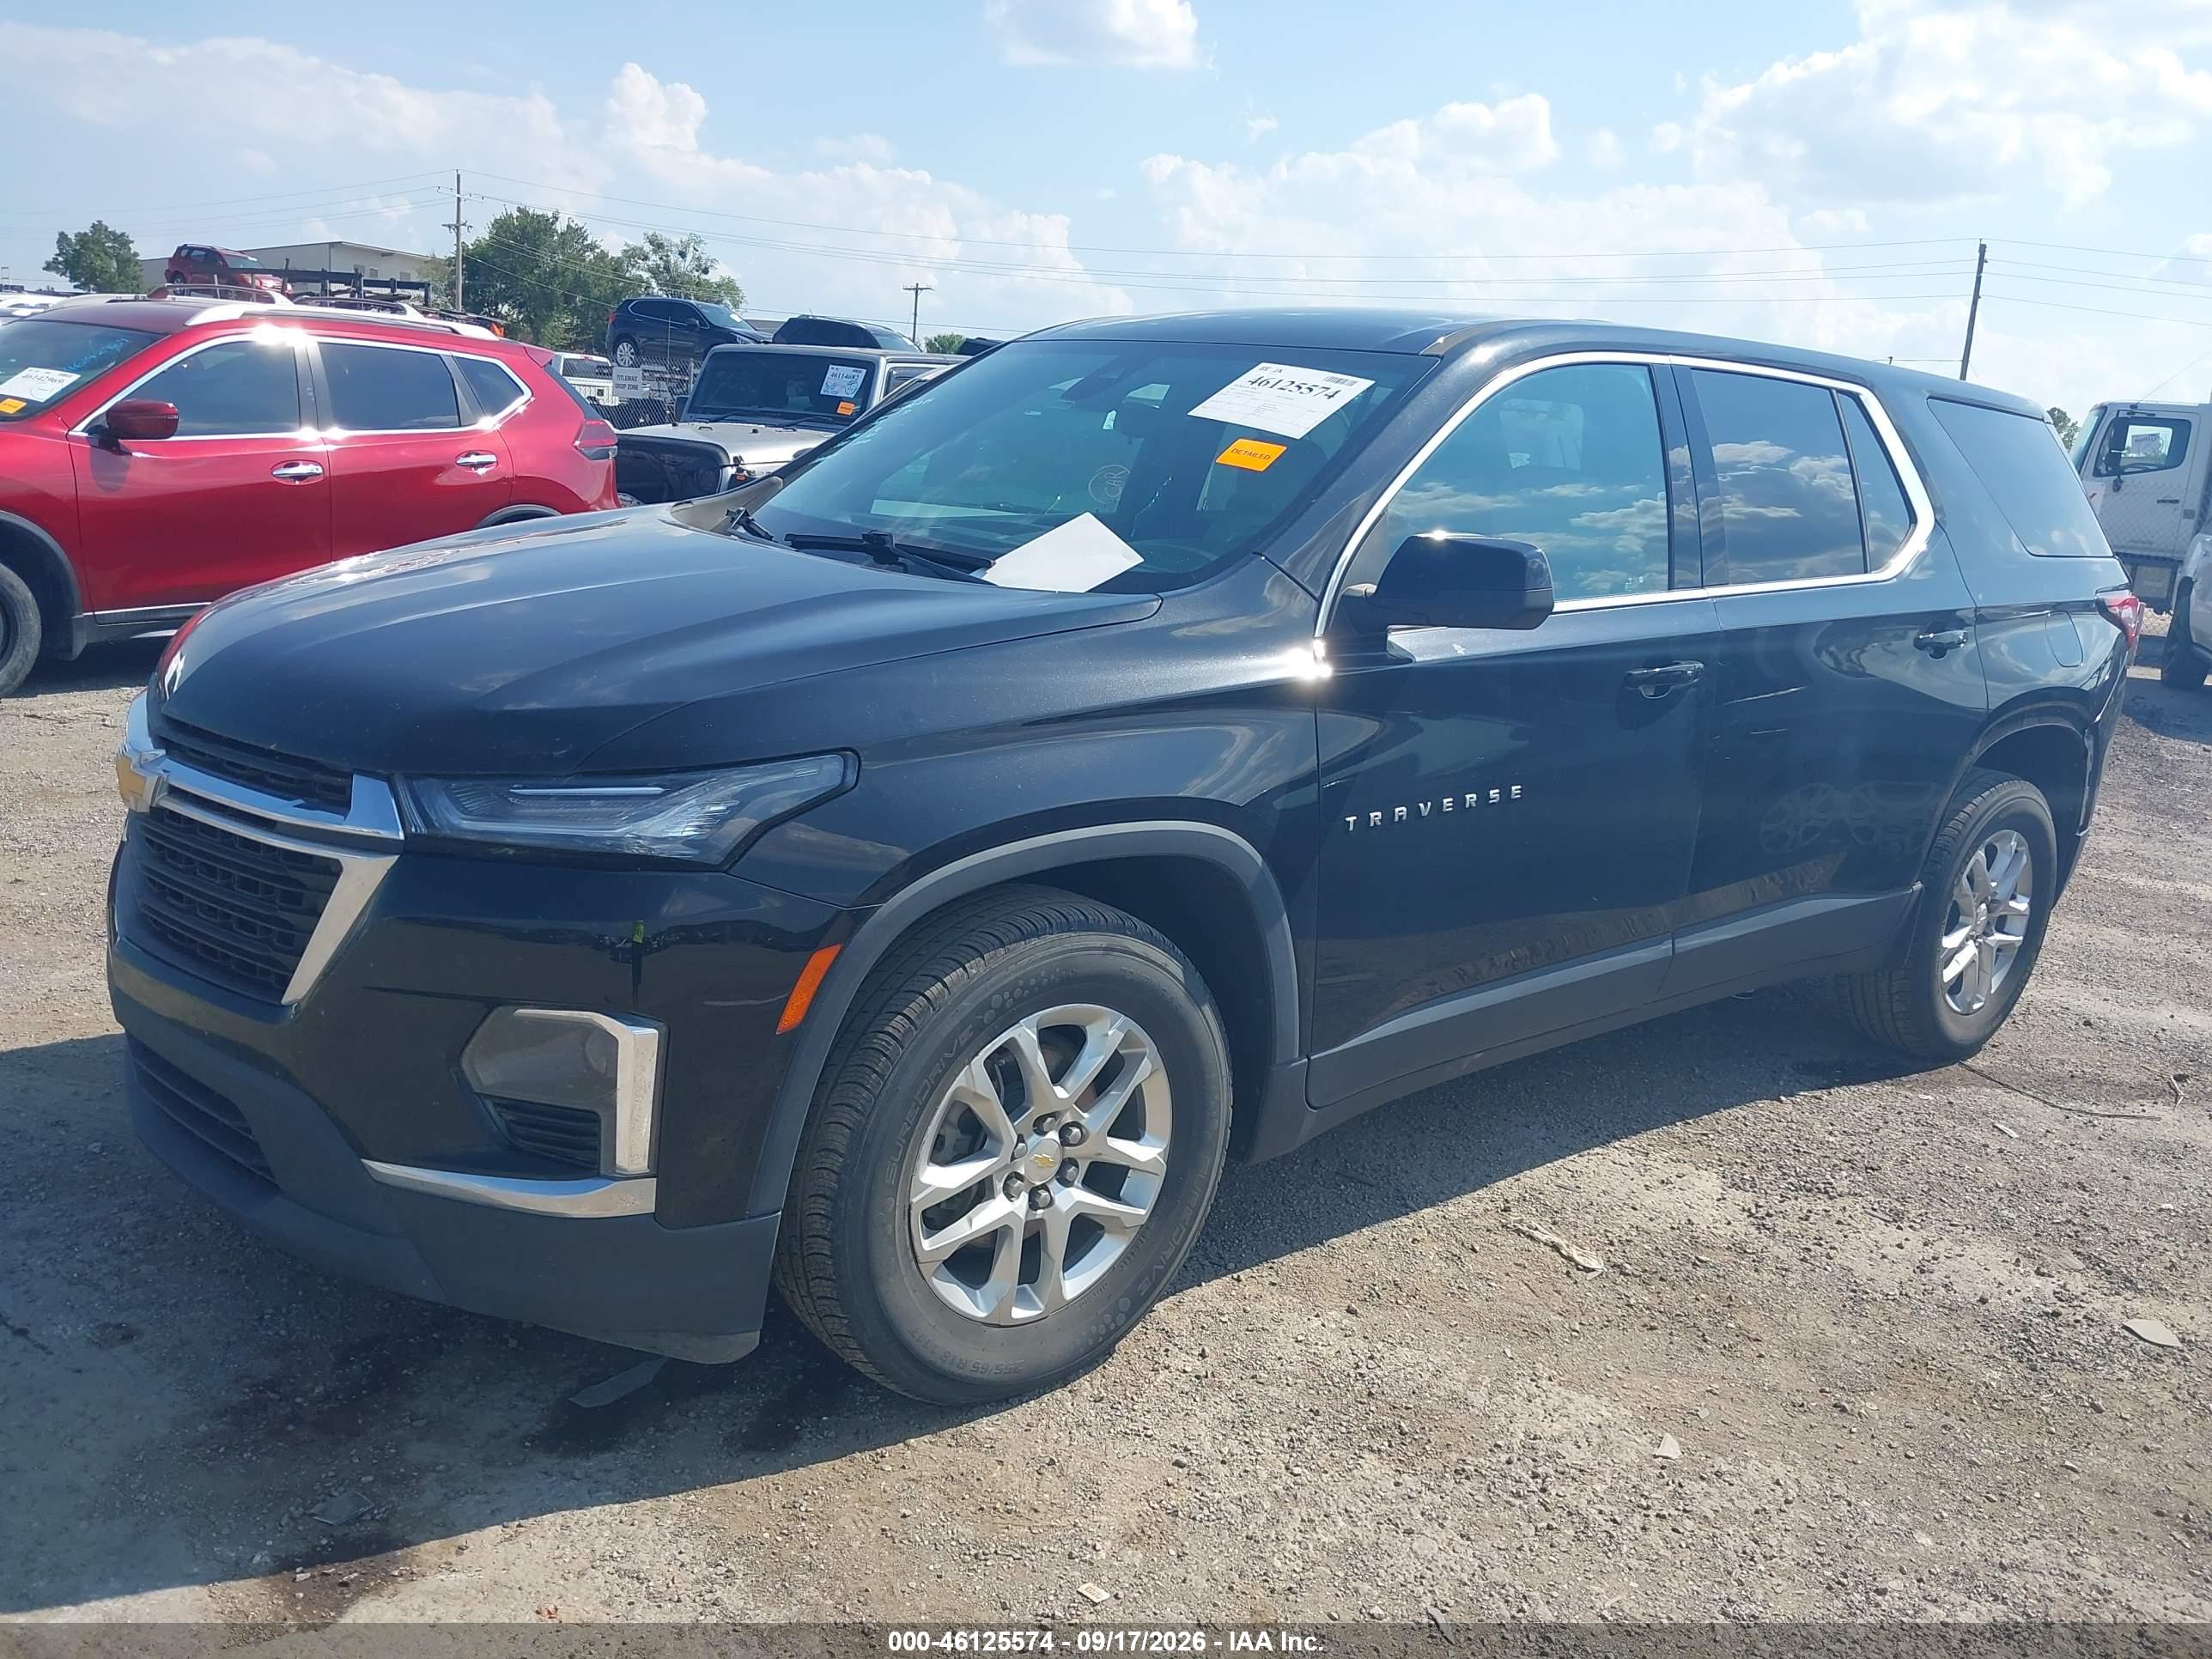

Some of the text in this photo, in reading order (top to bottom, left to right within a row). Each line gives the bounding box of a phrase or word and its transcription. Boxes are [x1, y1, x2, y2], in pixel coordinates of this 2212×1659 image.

[1247, 375, 1342, 400] 46125574
[1231, 447, 1271, 461] DETAILED
[1345, 785, 1522, 831] TRAVERSE
